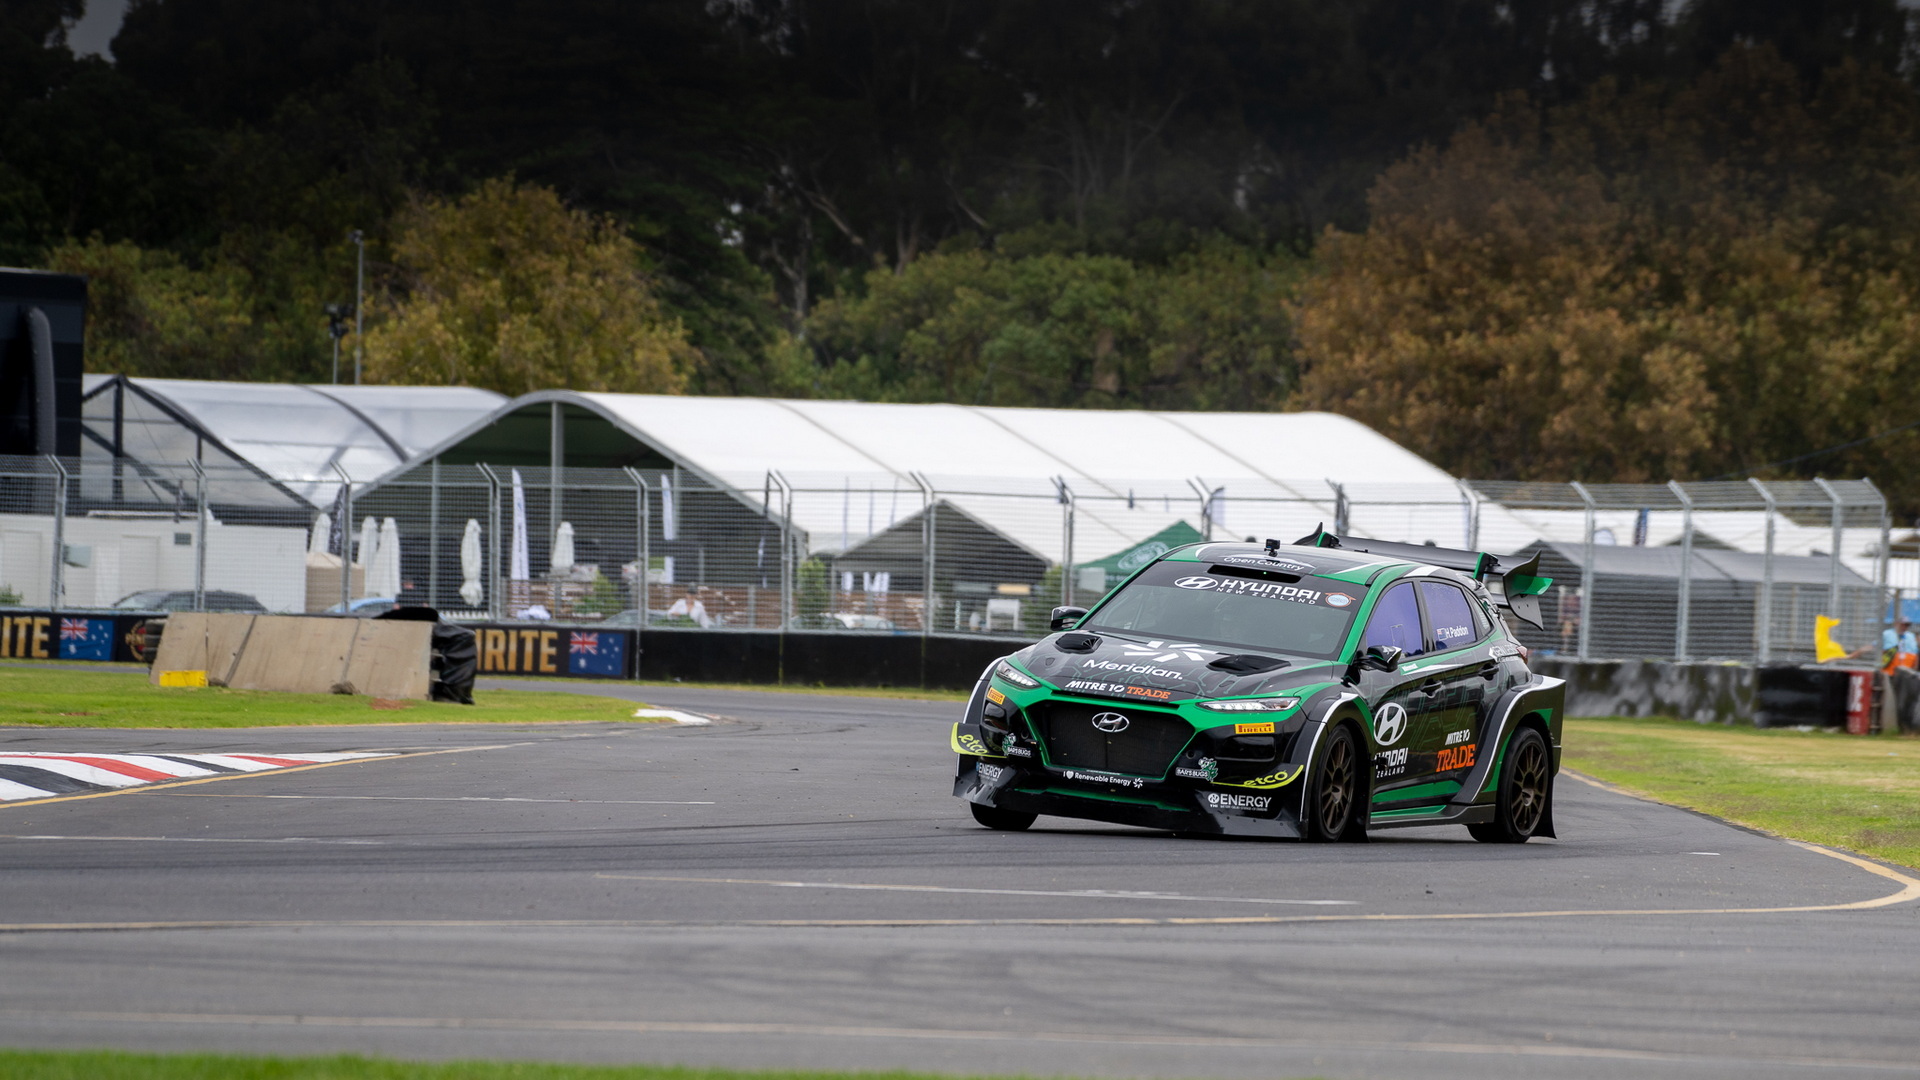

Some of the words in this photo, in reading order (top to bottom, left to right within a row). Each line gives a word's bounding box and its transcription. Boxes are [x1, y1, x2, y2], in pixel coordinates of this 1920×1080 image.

[1223, 557, 1256, 565] Open
[1257, 556, 1304, 572] Country
[1216, 587, 1244, 595] NEW
[1252, 591, 1316, 605] ZEALAND
[1221, 578, 1321, 600] HYUNDAI
[1082, 659, 1183, 680] Meridian.
[1065, 680, 1106, 691] MITRE
[1109, 683, 1125, 693] 10
[1126, 685, 1171, 699] TRADE
[1238, 724, 1272, 733] PIRELLI
[958, 734, 988, 754] etco
[1445, 730, 1463, 746] MITRE
[1436, 744, 1476, 772] TRADE
[978, 762, 1003, 779] ENERGY
[1243, 771, 1288, 786] etco
[1376, 766, 1405, 778] ZEALAND
[1074, 773, 1108, 783] Renewable
[1109, 776, 1132, 786] Energy
[1220, 793, 1272, 808] ENERGY
